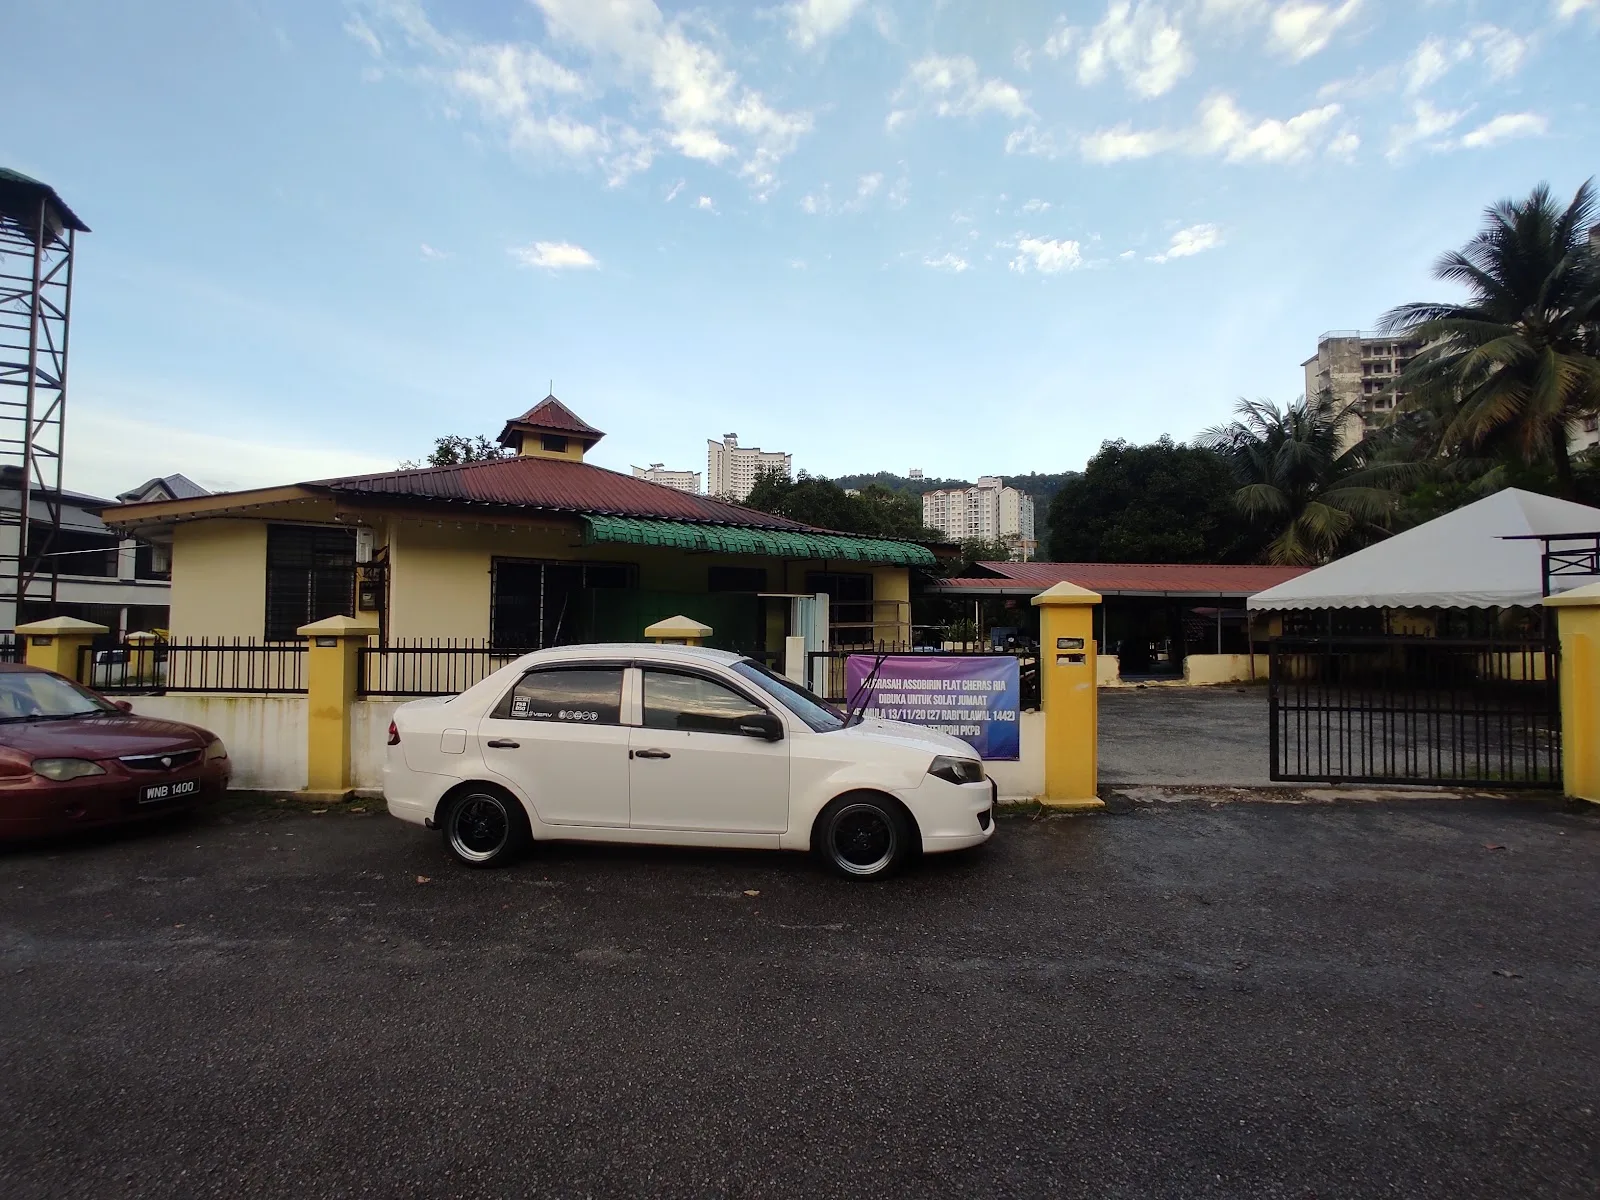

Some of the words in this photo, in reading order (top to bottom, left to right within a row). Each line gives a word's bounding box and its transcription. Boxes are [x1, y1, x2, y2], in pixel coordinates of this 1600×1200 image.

[903, 679, 941, 690] ASSOBIRIN
[943, 680, 961, 690] FLAT
[962, 680, 991, 691] CHERAS
[993, 681, 1006, 691] RIA
[879, 694, 906, 704] DIBUKA
[907, 694, 932, 705] UNTUK
[933, 695, 957, 705] SOLAT
[958, 695, 987, 706] JUMAAT
[888, 709, 926, 720] 13/11/20
[927, 710, 940, 720] (27
[993, 711, 1015, 721] 1442)
[960, 725, 981, 735] PKPB
[147, 786, 168, 799] WNB
[172, 781, 194, 795] 1400
